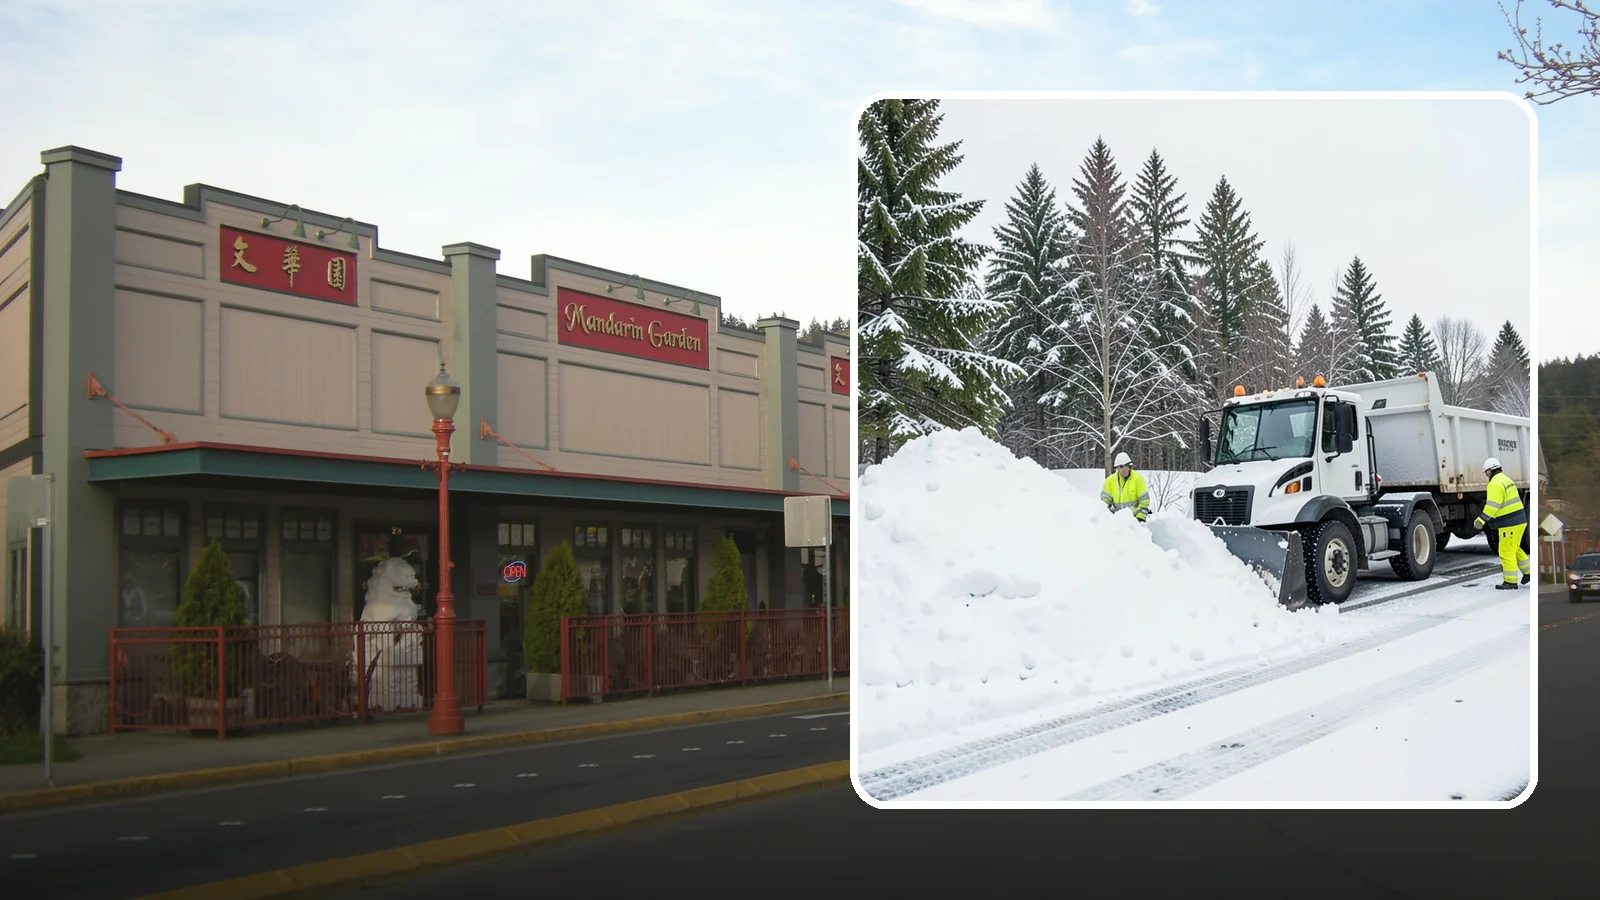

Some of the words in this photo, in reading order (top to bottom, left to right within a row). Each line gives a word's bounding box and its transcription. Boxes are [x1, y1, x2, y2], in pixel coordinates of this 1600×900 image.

[564, 302, 643, 341] Mandarin
[648, 320, 701, 352] Garden
[503, 565, 526, 578] OPEN
